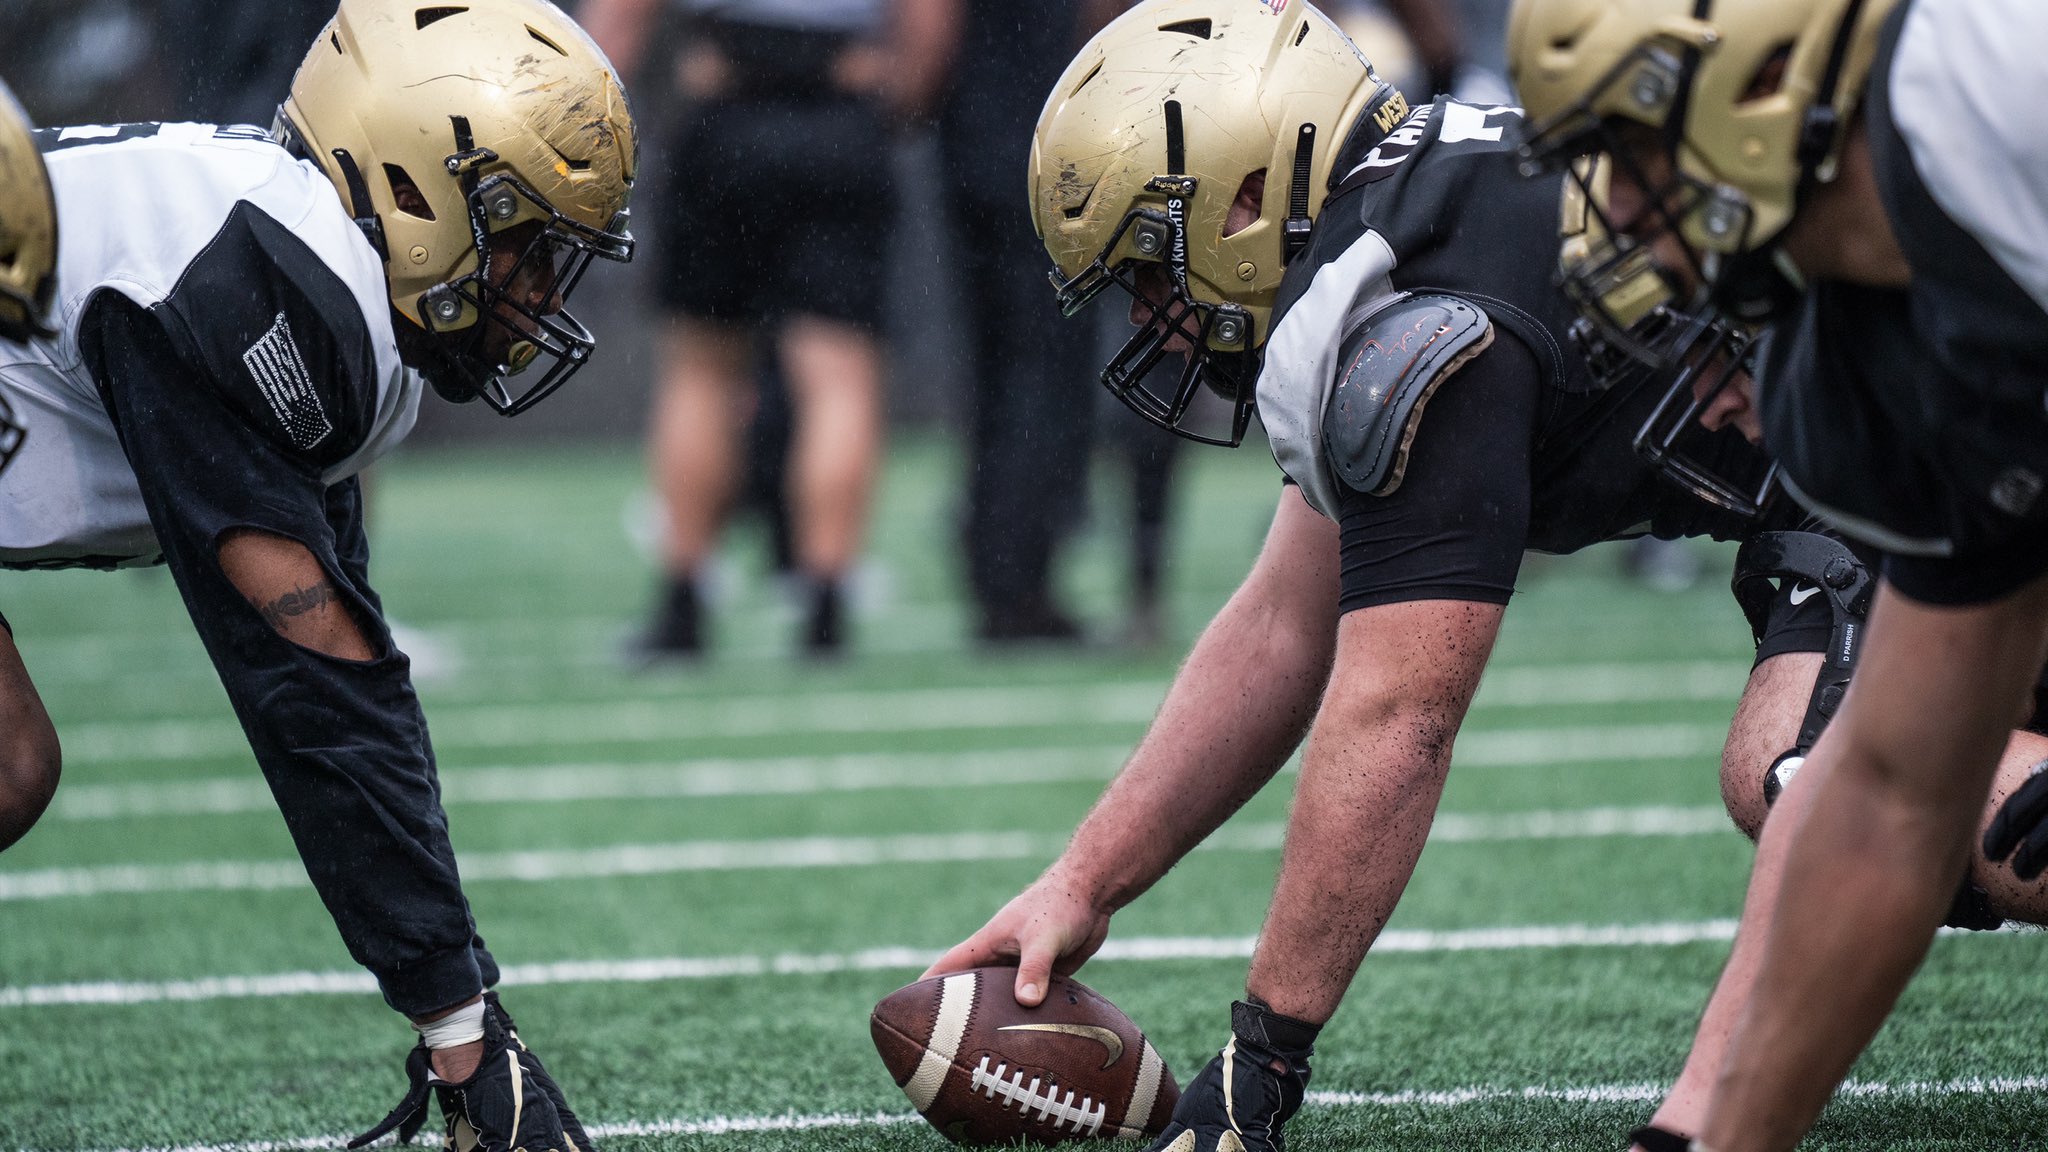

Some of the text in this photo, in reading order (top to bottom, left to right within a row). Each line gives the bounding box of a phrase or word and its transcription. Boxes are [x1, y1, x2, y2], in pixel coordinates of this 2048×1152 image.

[1373, 91, 1410, 134] WEST
[1155, 180, 1181, 191] Riddell
[1844, 624, 1854, 655] PARRISH
